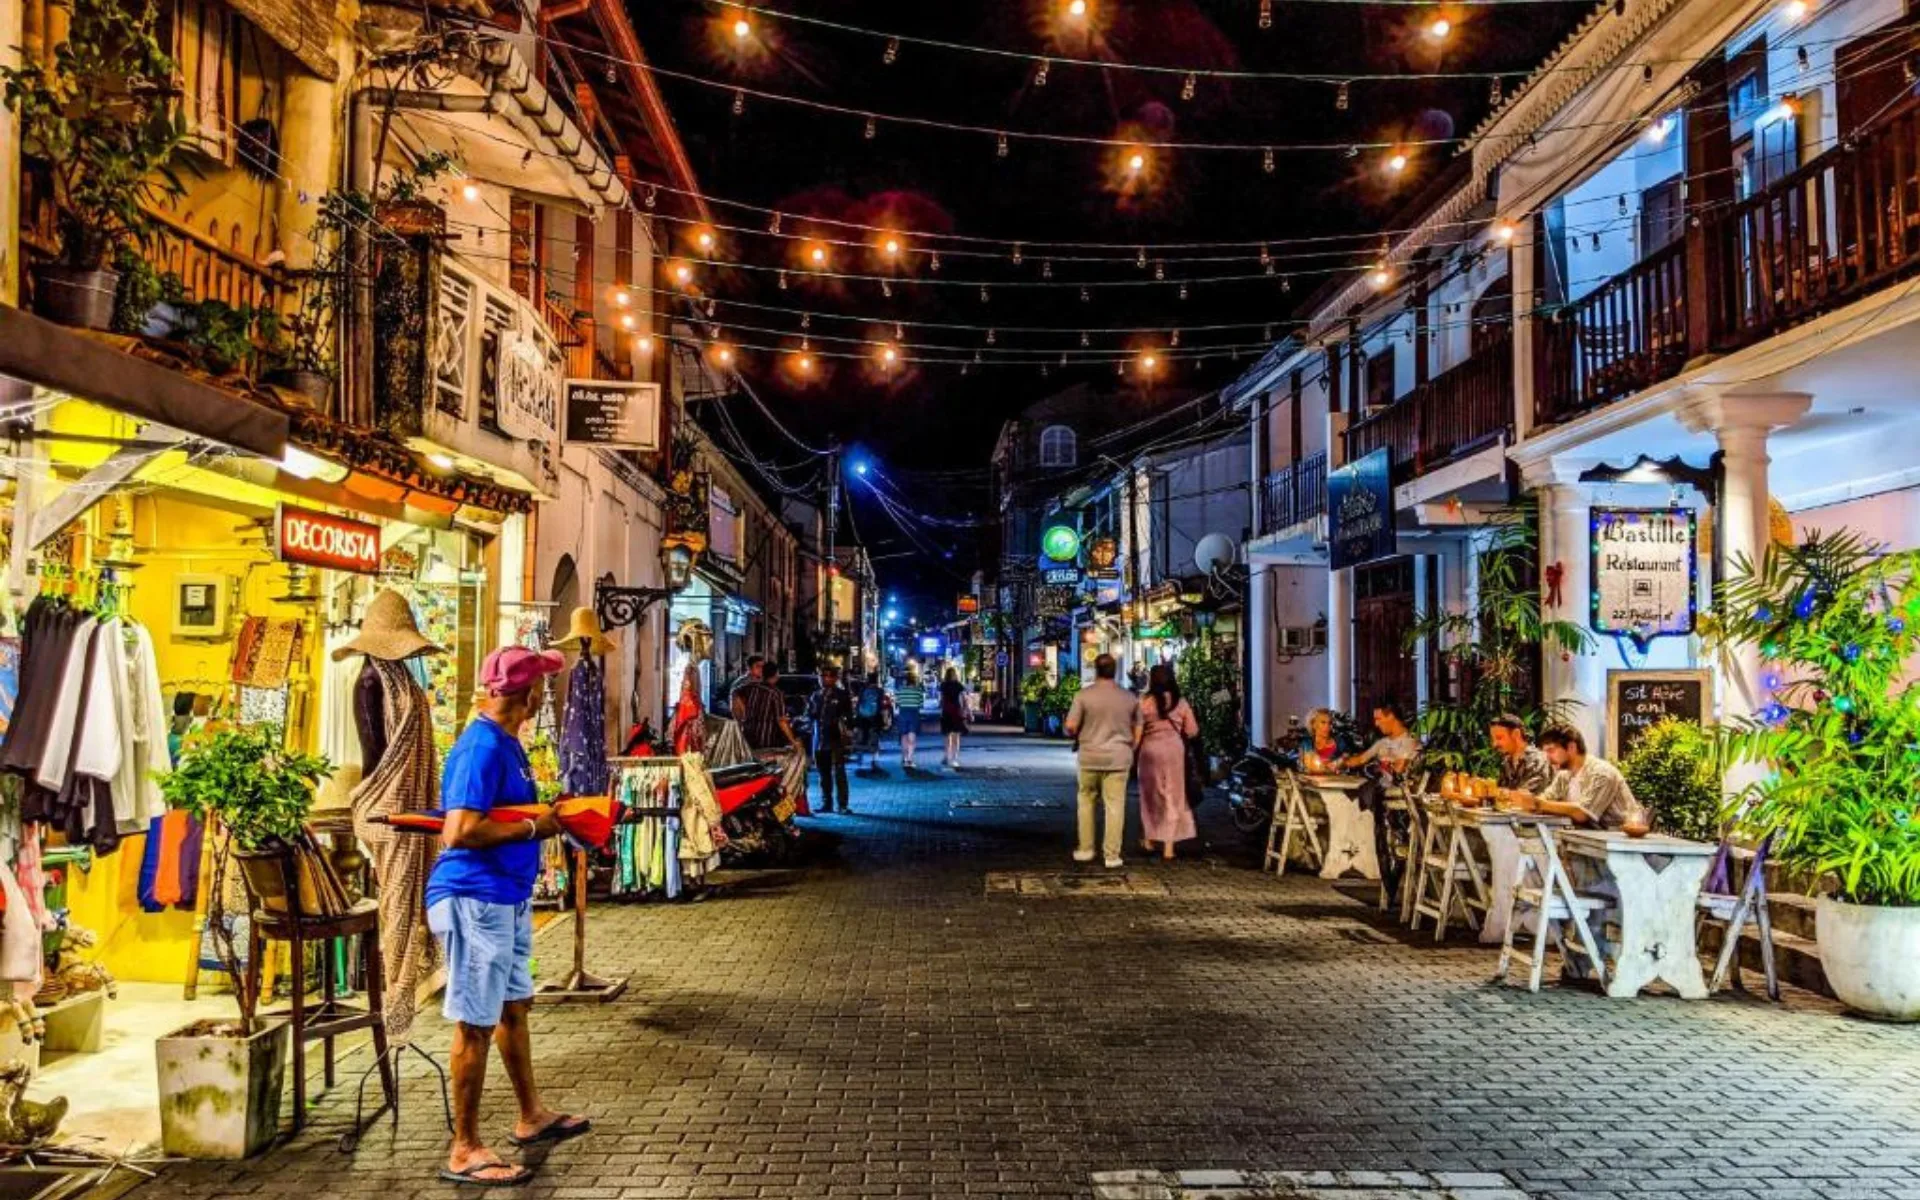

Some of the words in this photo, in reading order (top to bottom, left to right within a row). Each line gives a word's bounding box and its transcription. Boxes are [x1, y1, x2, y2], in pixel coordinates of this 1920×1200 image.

[286, 518, 377, 563] DECORISTA
[1602, 517, 1685, 544] Bastille
[1606, 554, 1682, 572] Restaurant
